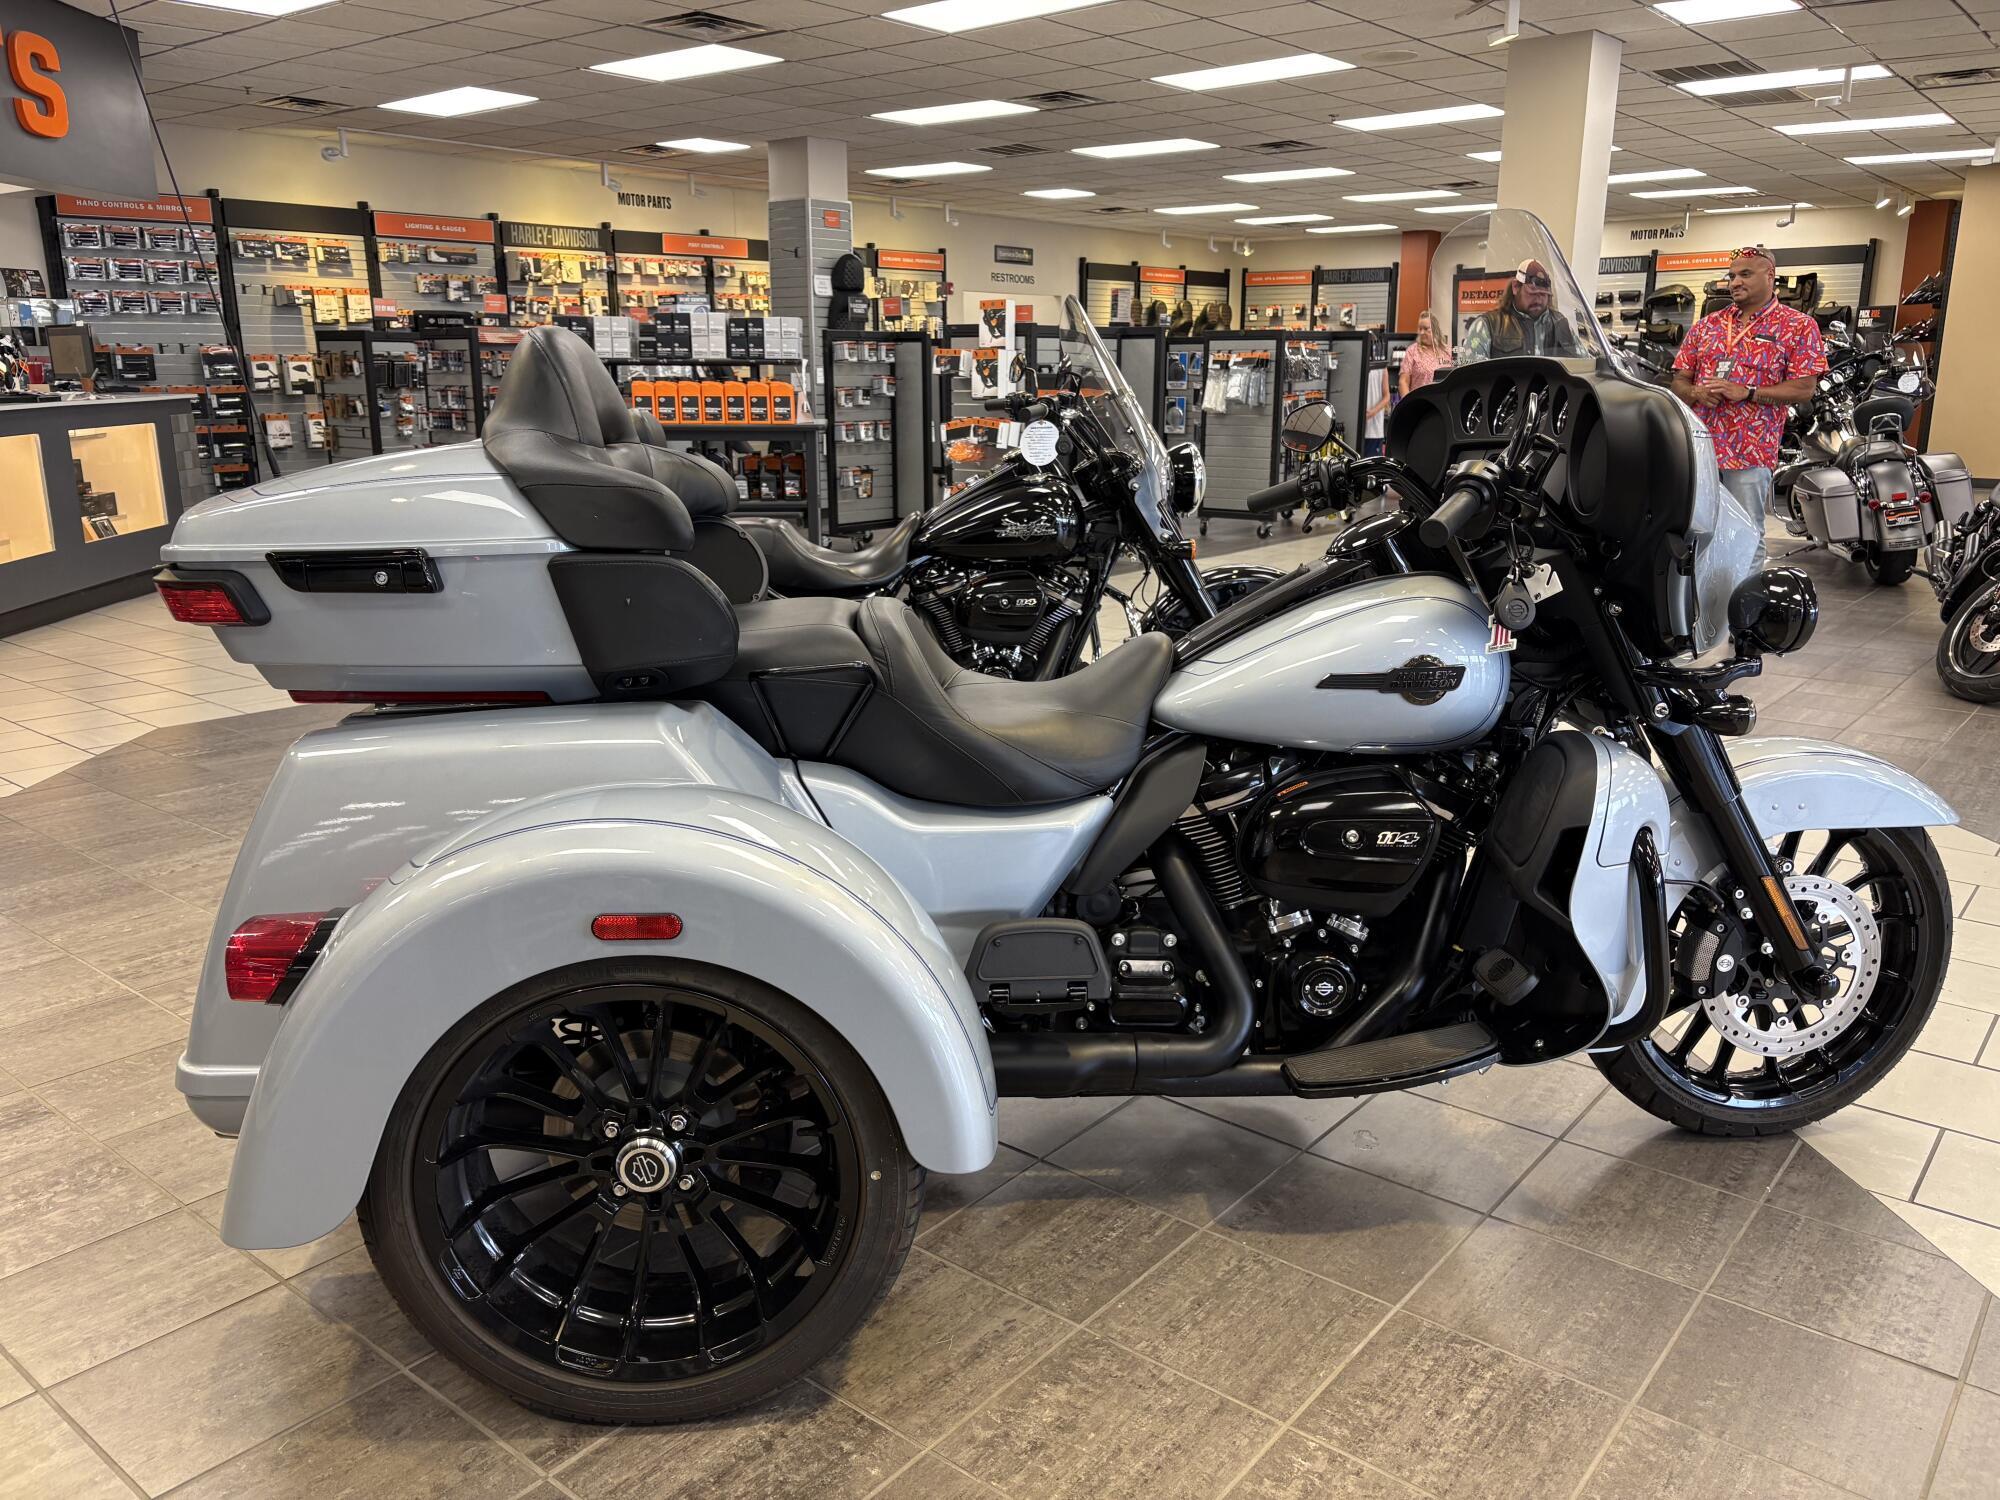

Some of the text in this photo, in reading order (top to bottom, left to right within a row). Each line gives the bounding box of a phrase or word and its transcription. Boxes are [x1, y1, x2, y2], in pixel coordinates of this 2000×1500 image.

[0, 26, 69, 138] S
[76, 199, 99, 207] HAND
[101, 201, 145, 210] CONTROLS
[617, 192, 672, 210] MOTOR PARTS
[404, 222, 434, 230] LIGHTING
[510, 224, 599, 249] HARLEY-DAVIDSON
[1630, 229, 1658, 241] MOTOR
[990, 272, 1035, 285] RESTROOMS
[1323, 269, 1385, 282] HARLEY-DAVIDSON
[1376, 831, 1420, 845] 114
